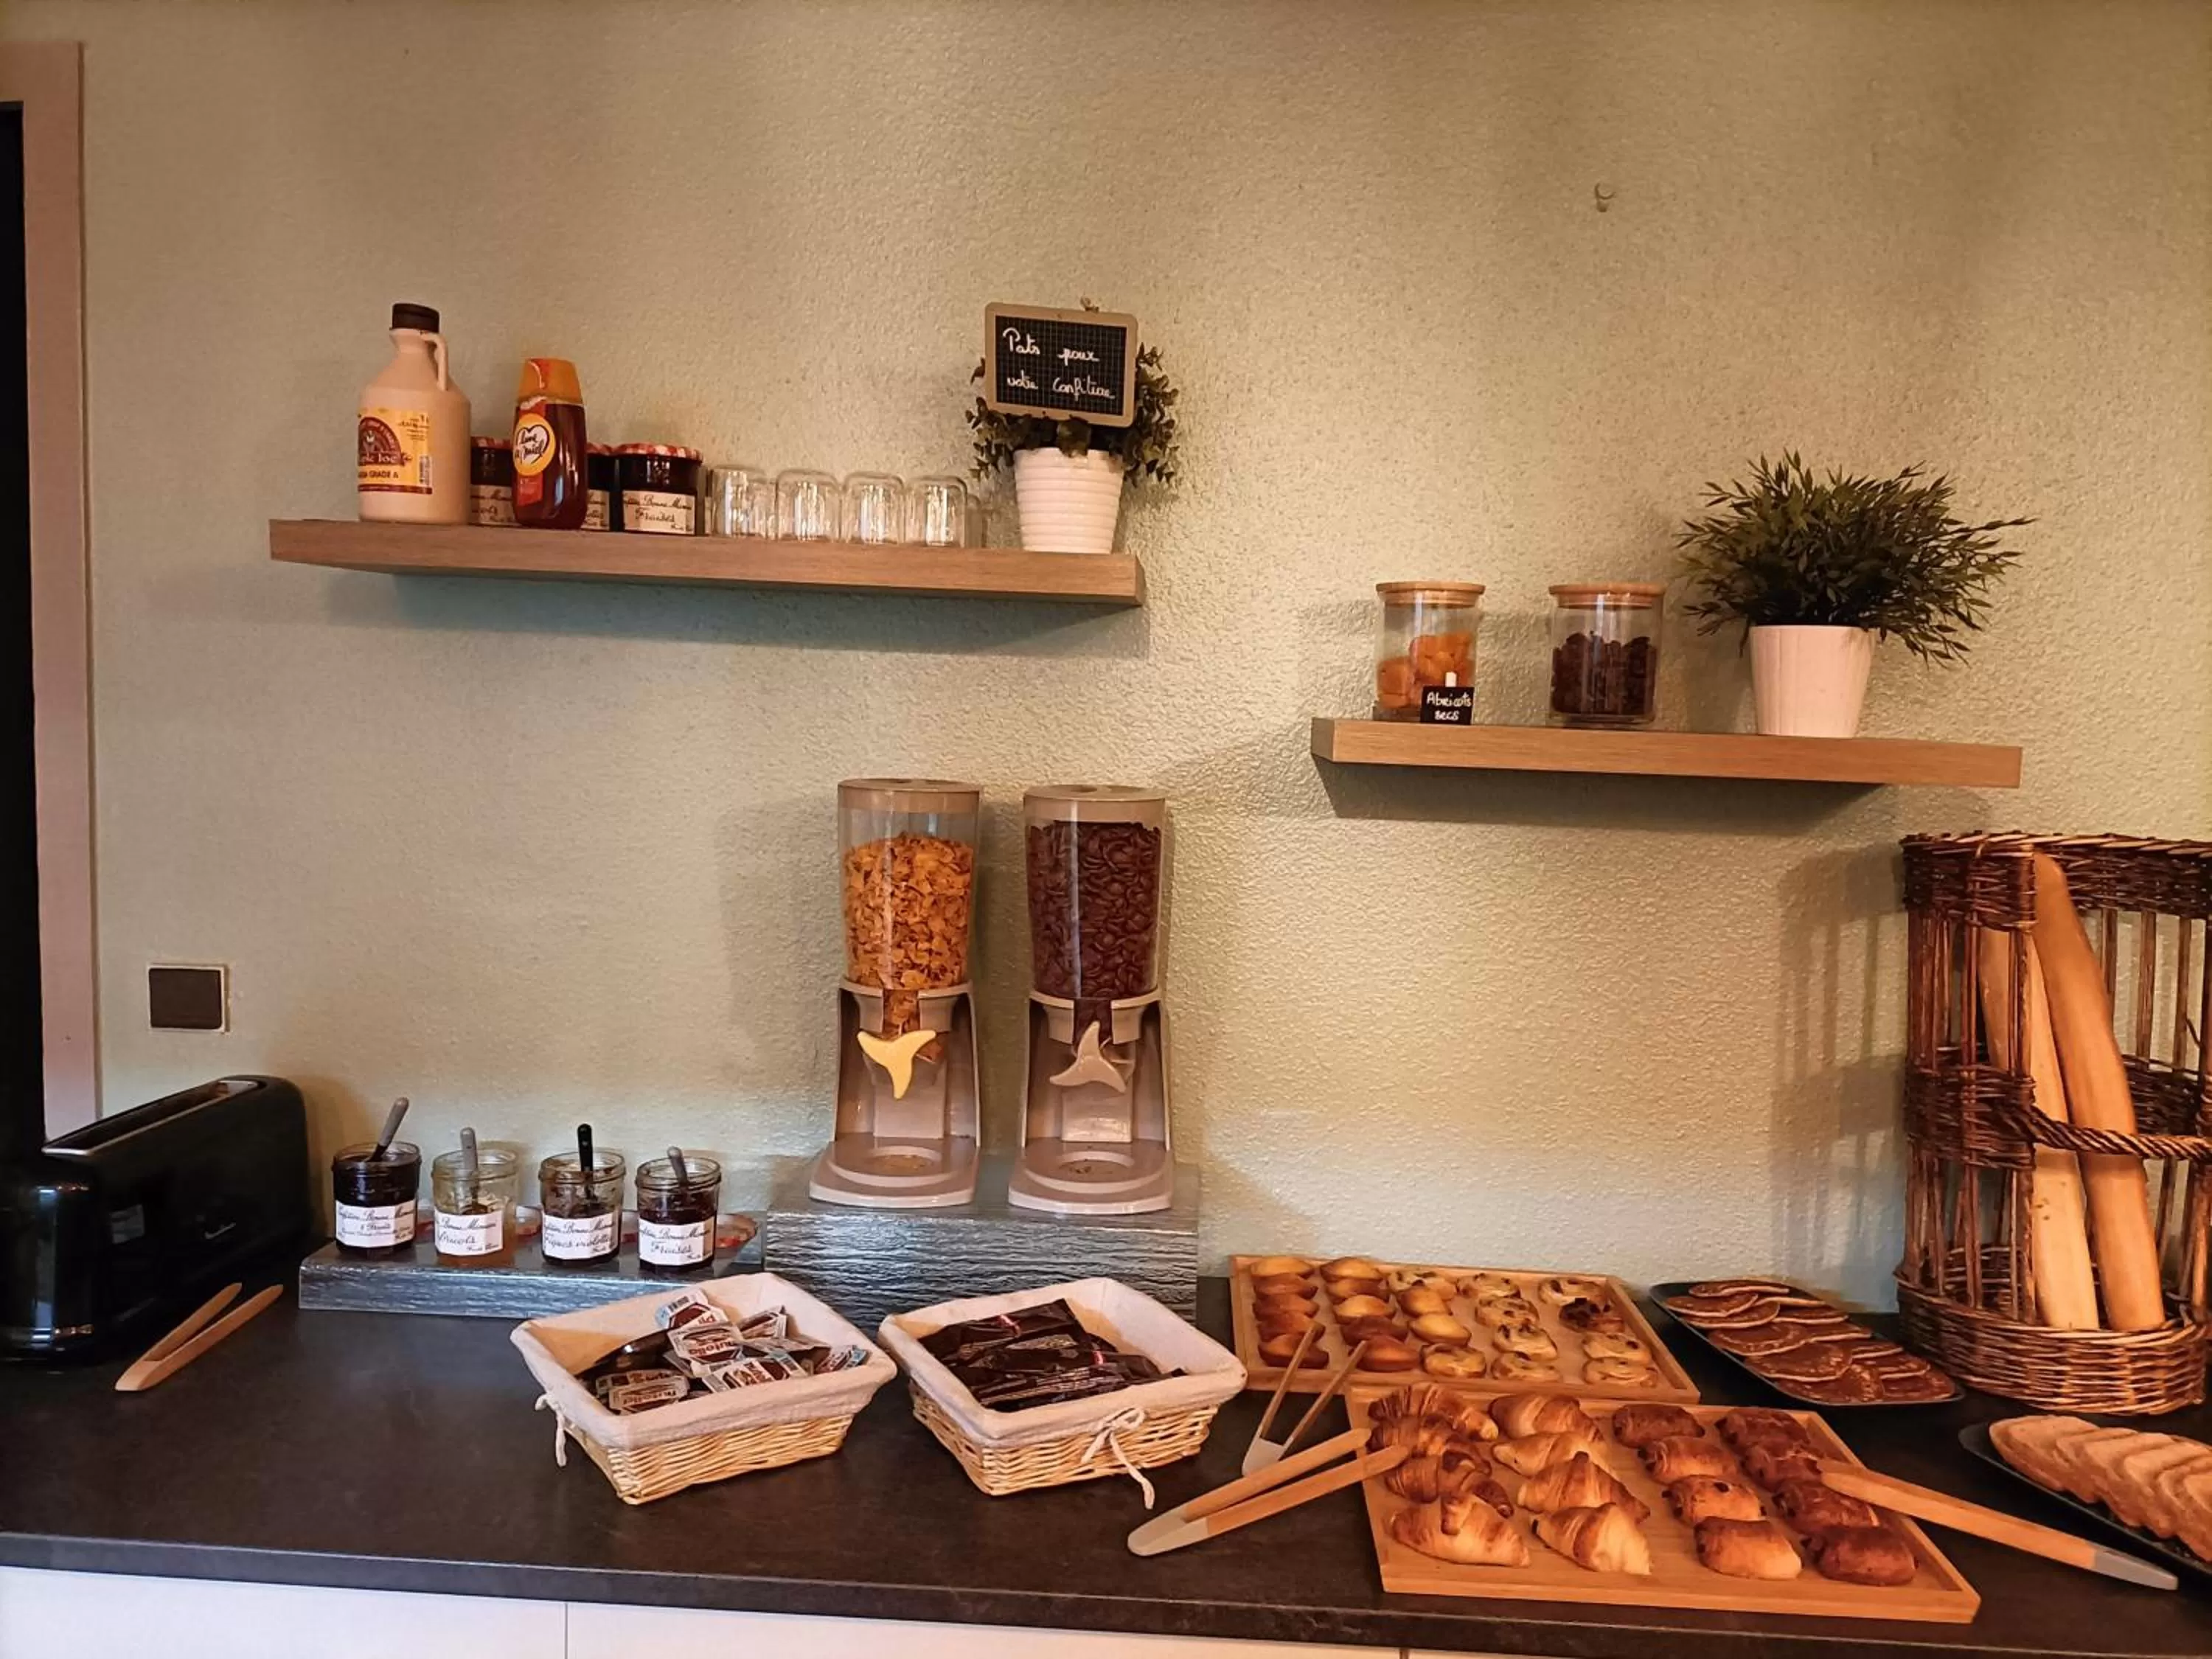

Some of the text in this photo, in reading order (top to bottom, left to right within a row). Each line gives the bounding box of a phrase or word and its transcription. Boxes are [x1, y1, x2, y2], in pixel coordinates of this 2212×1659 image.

[1057, 347, 1100, 366] pour
[1006, 369, 1039, 390] votre
[1427, 691, 1472, 707] Abricots
